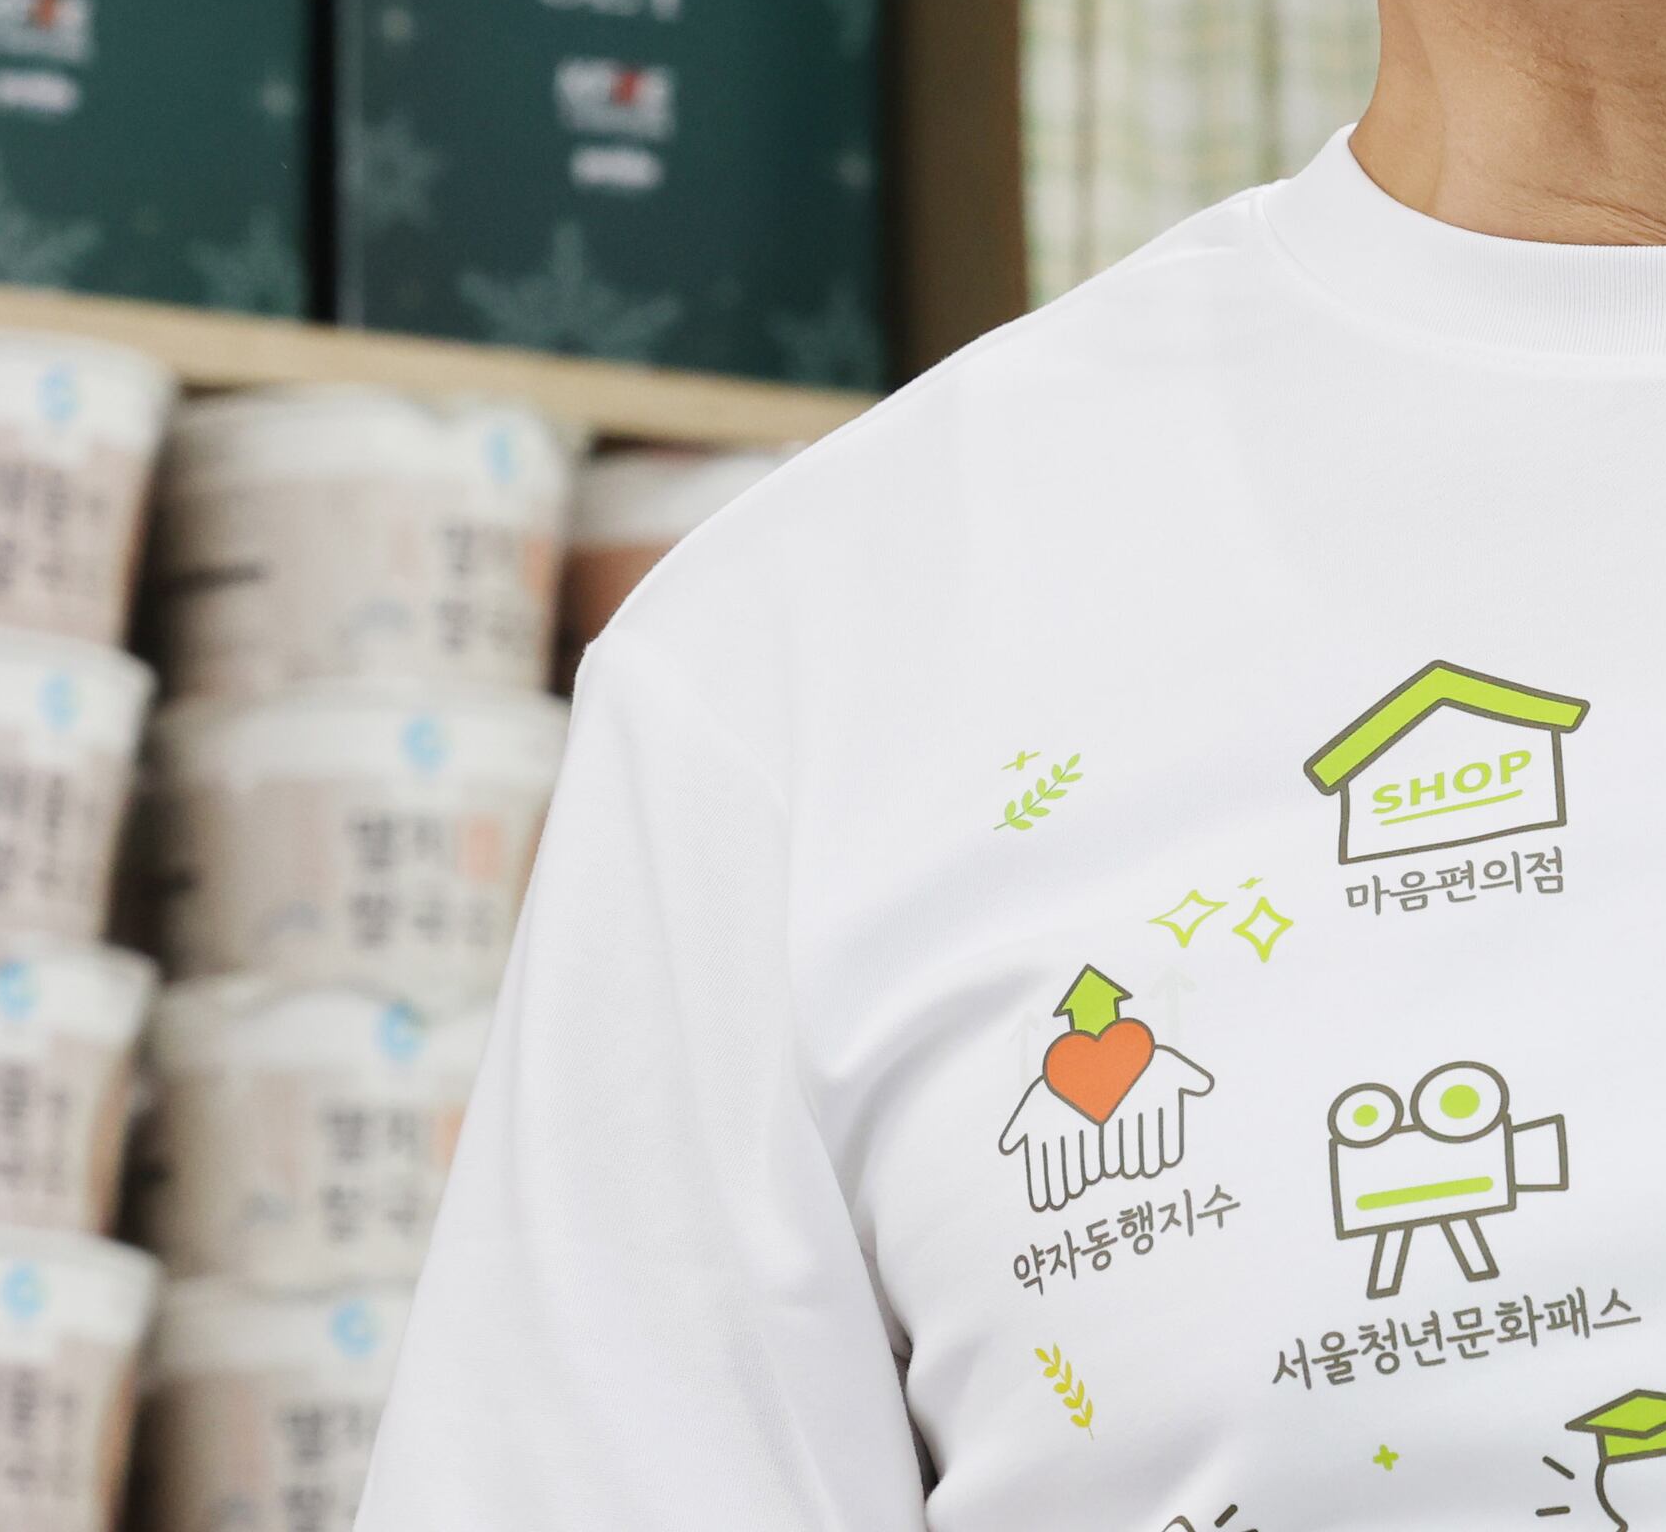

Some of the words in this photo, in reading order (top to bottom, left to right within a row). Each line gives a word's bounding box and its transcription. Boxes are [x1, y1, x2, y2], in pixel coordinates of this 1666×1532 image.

[1370, 749, 1532, 814] SHOP
[1345, 845, 1565, 916] 마음편의점
[1013, 1184, 1241, 1296] 약자동행지수
[1272, 1287, 1642, 1390] 서울청년문화패스
